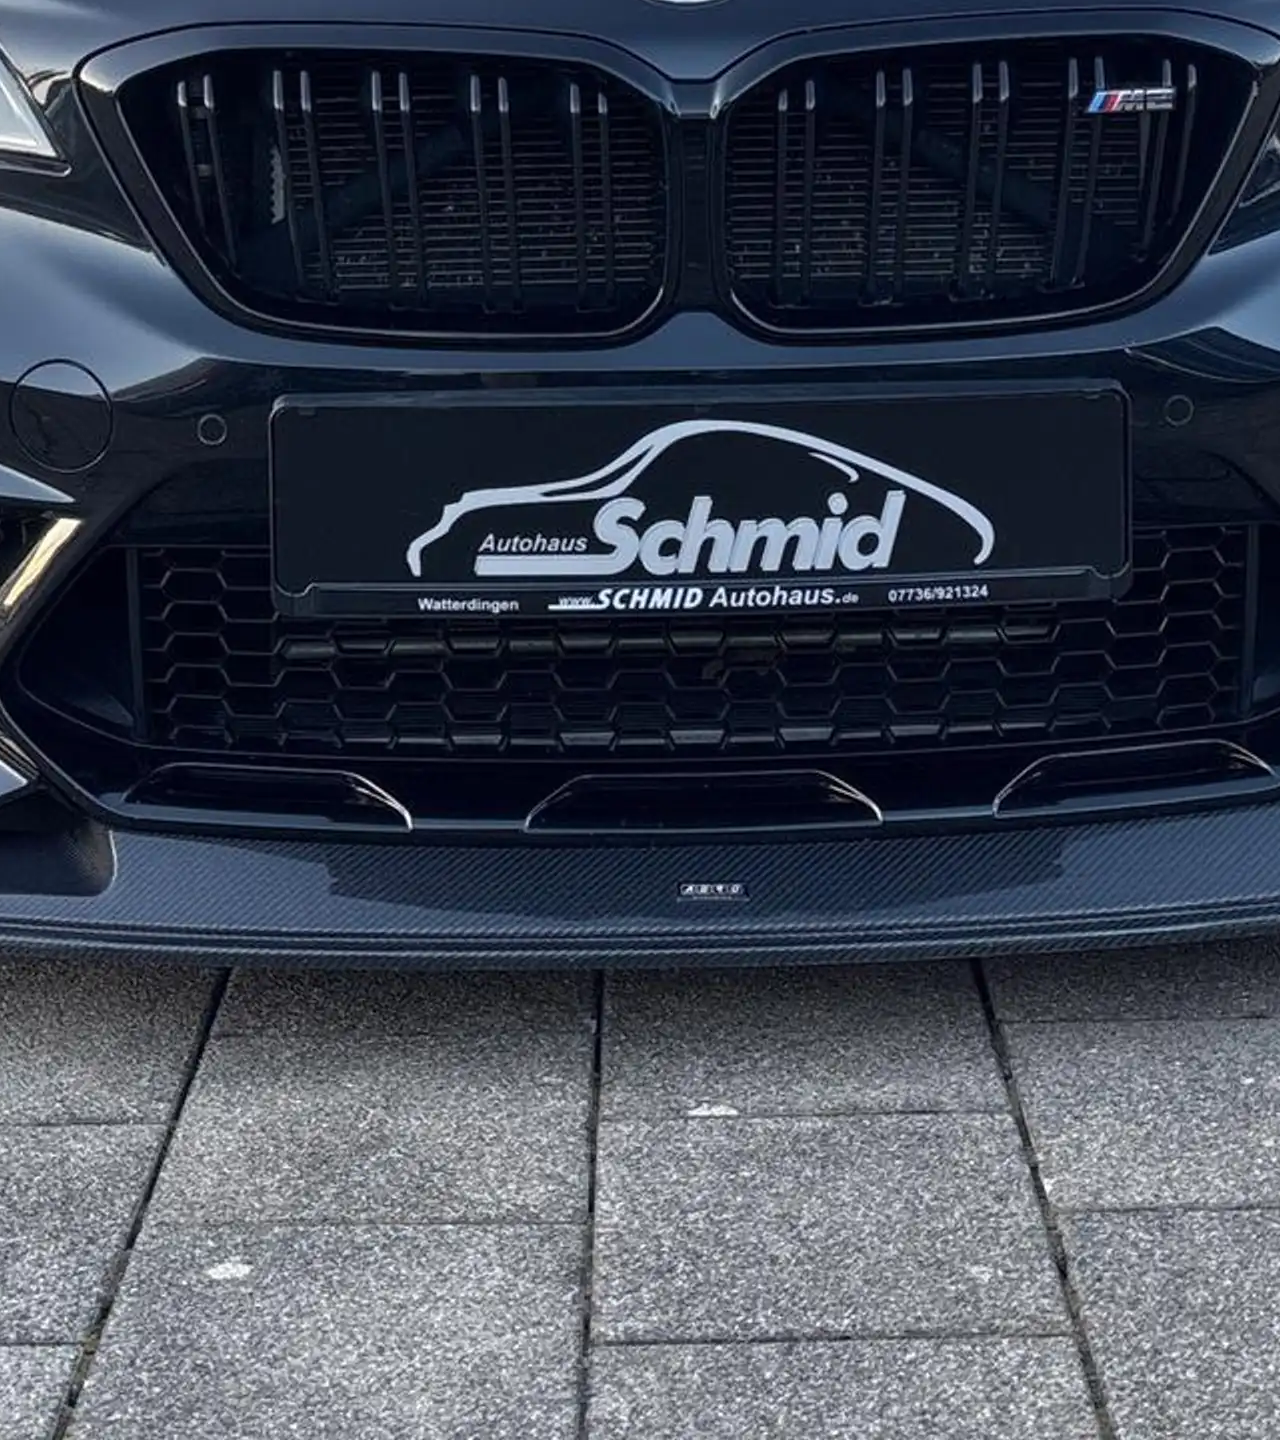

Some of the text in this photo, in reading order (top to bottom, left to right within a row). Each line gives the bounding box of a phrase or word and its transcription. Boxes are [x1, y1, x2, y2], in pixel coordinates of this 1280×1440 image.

[475, 489, 907, 576] Autohaus Schmid
[417, 596, 520, 614] Watterdingen
[709, 585, 859, 608] Autohaus.de
[887, 584, 990, 603] 07736/921324
